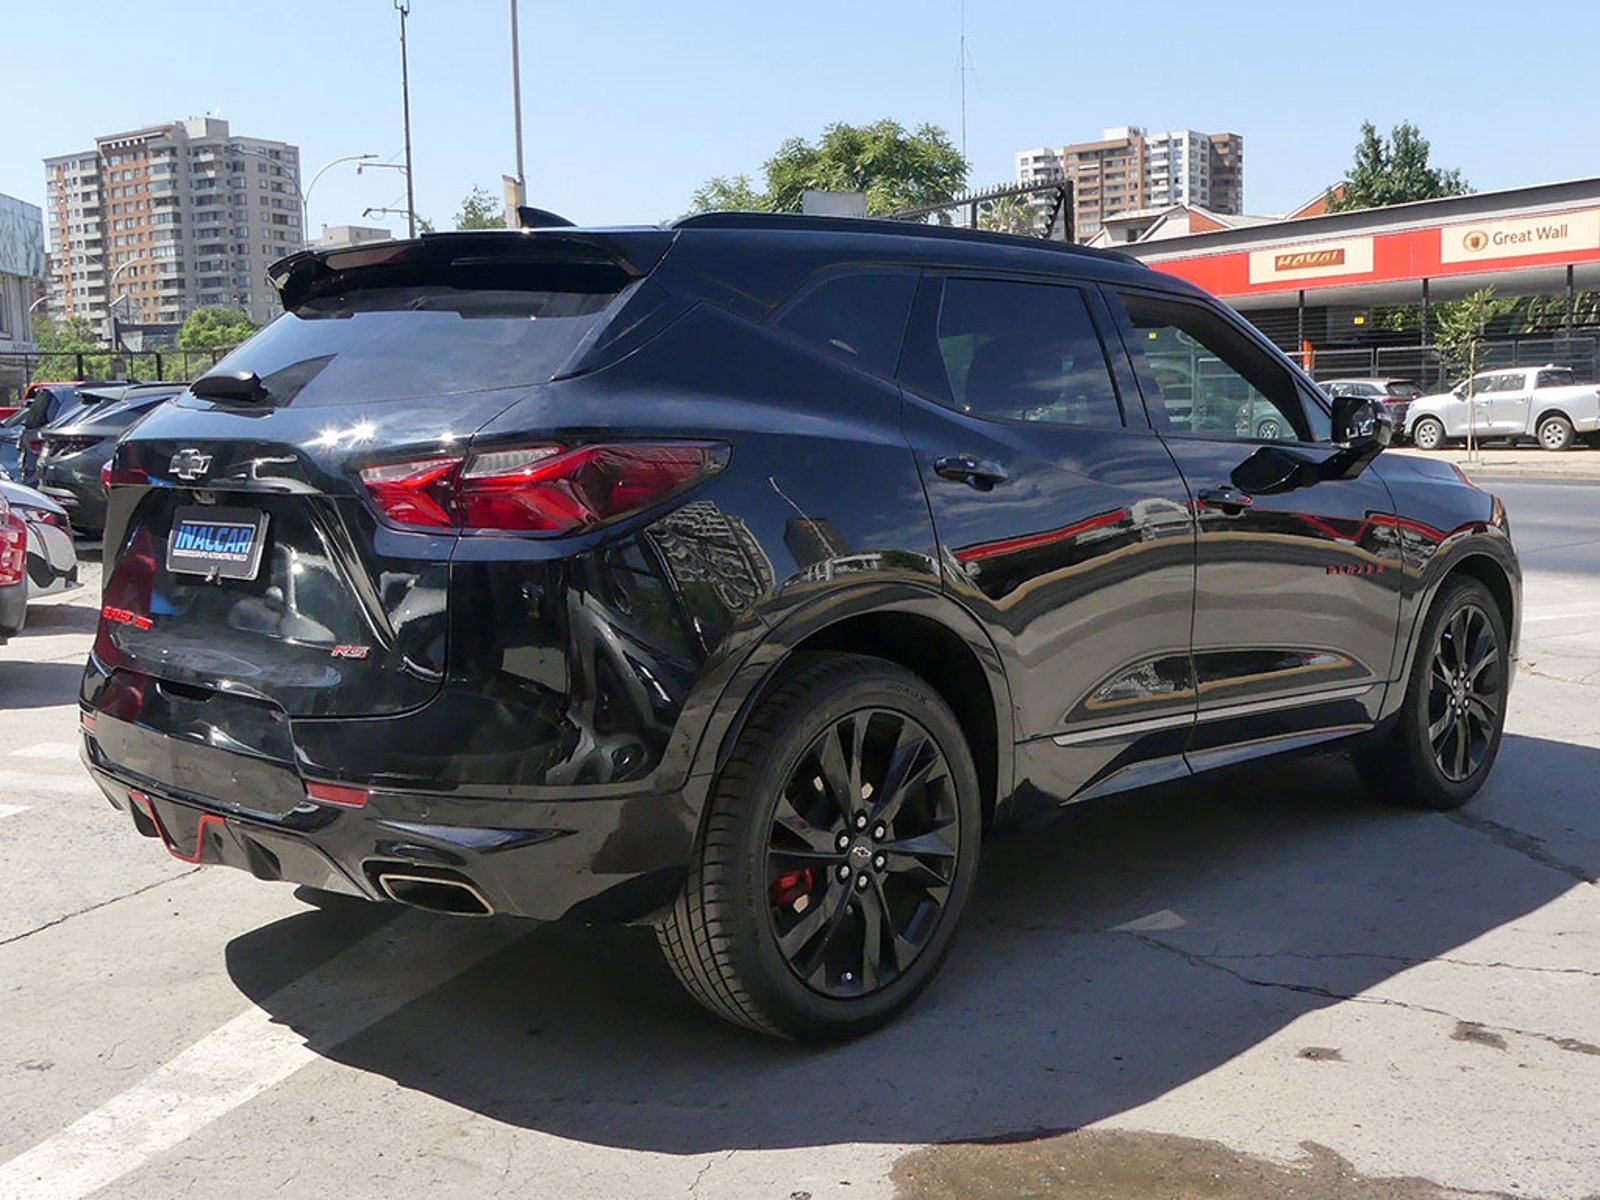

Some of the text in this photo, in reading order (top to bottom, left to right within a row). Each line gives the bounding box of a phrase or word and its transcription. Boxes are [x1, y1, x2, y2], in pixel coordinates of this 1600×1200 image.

[1492, 223, 1569, 246] Great Wall
[174, 525, 252, 554] INALCAR
